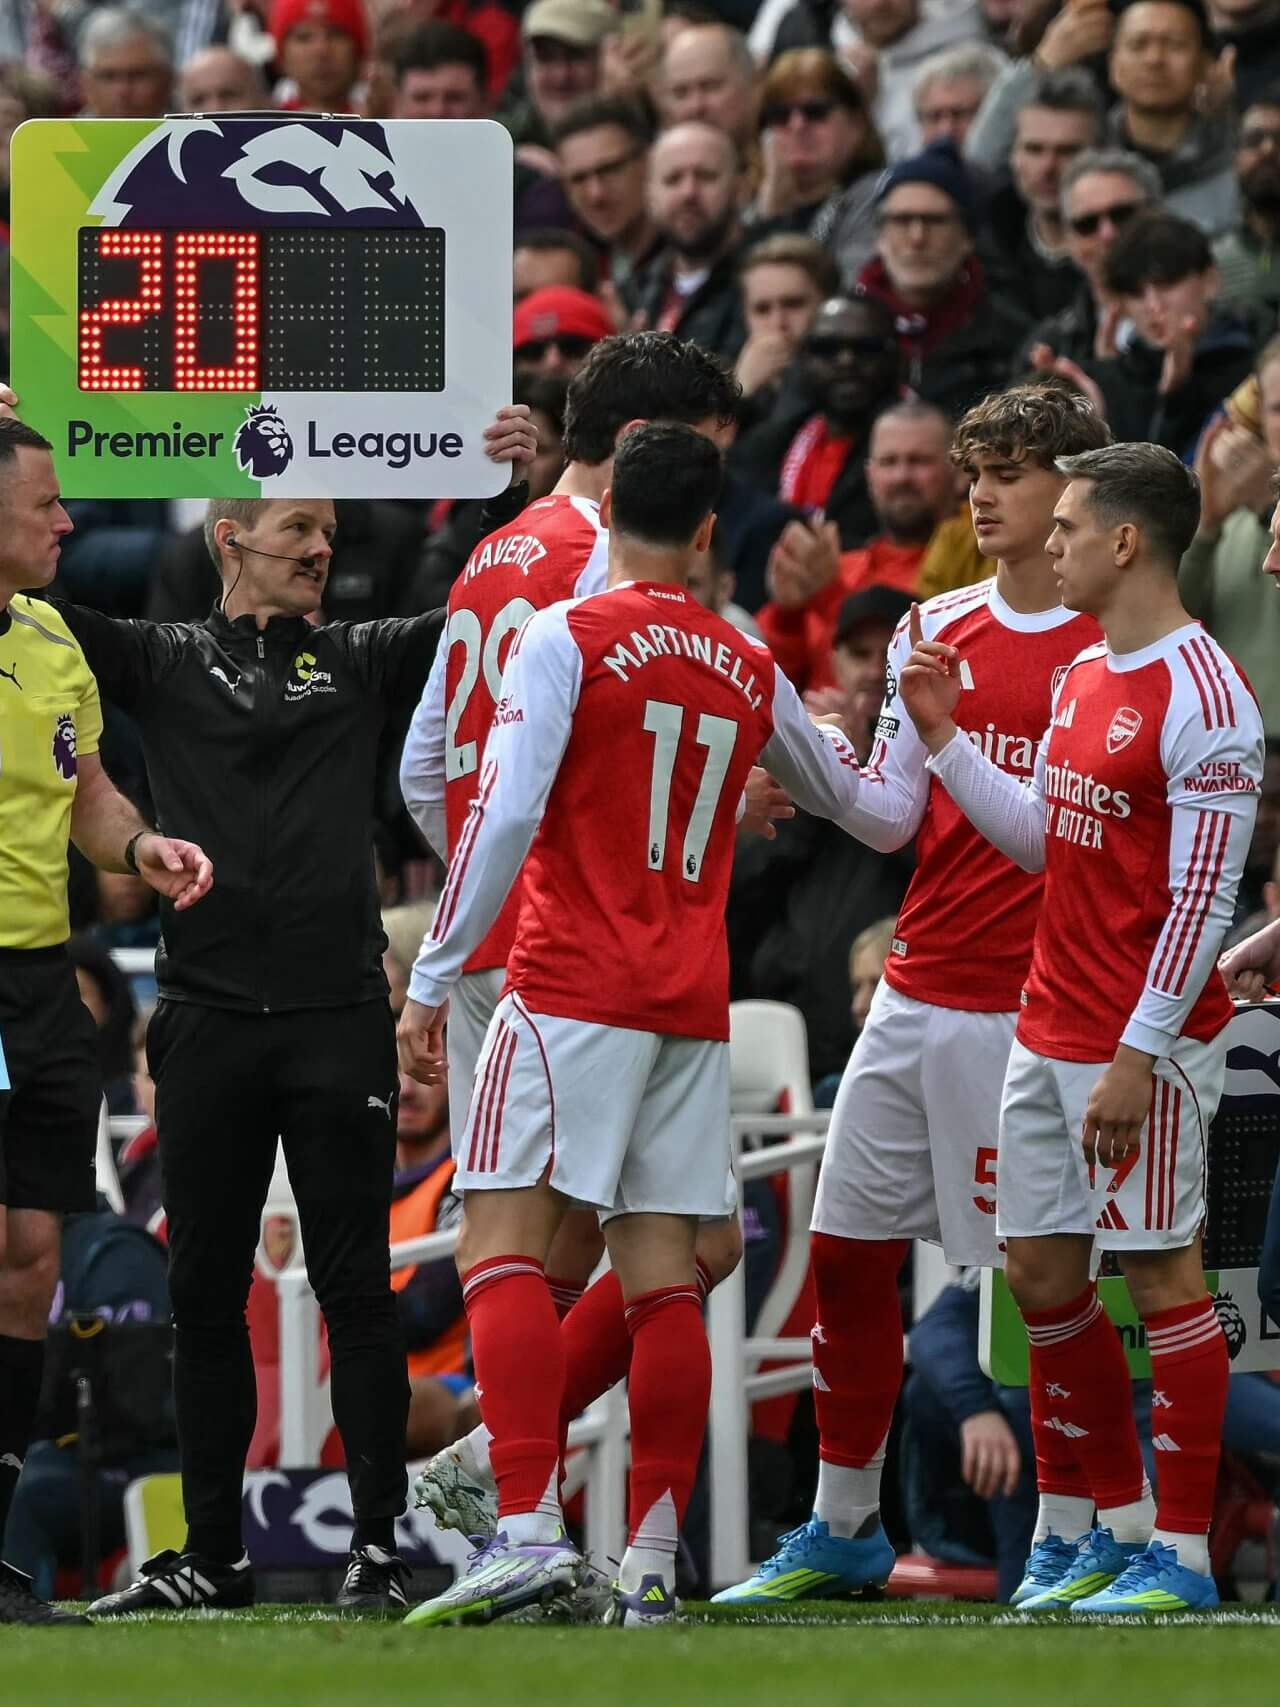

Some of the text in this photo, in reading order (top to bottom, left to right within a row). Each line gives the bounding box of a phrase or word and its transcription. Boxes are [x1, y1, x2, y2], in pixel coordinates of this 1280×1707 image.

[80, 232, 258, 391] 20
[67, 420, 463, 469] Premier League
[643, 699, 739, 884] 11
[1044, 759, 1132, 819] mirates
[1183, 777, 1256, 792] RWANDA
[1198, 762, 1241, 777] VISIT
